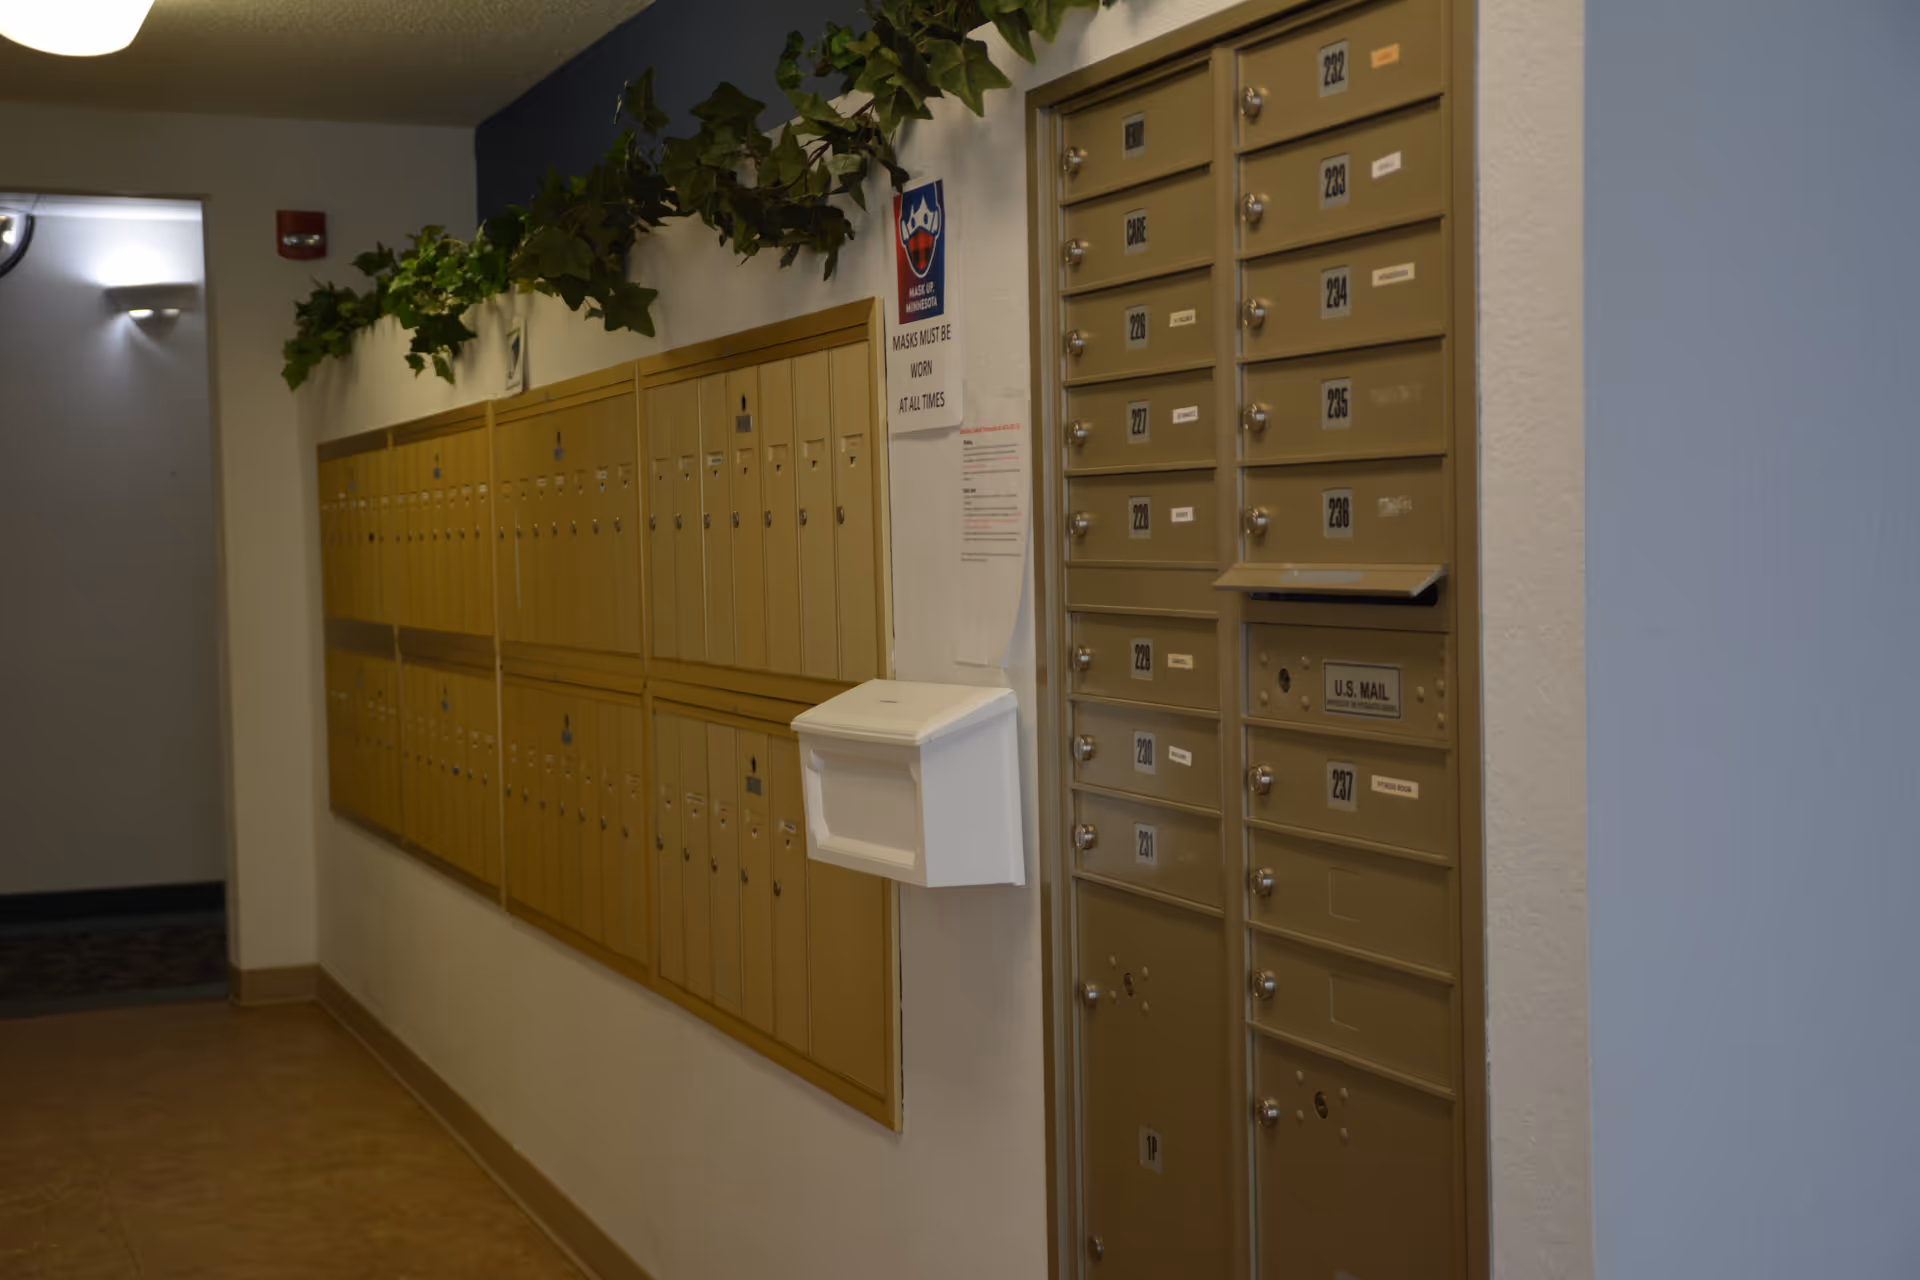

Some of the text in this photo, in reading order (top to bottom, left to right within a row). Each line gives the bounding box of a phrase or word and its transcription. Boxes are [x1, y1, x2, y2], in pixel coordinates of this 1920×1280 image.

[1324, 51, 1345, 86] 232
[1325, 163, 1346, 198] 233
[906, 296, 938, 313] MINNESOTA
[909, 284, 925, 298] MASK
[1326, 275, 1348, 309] 234
[893, 324, 952, 352] MASKS MUST BE
[910, 360, 933, 378] WORN
[899, 391, 945, 413] AT ALL TIMES
[1327, 387, 1349, 419] 235
[1132, 408, 1147, 434] 227
[1334, 679, 1390, 701] U.S. MAIL
[1137, 738, 1153, 766] 230
[1332, 769, 1353, 802] 237
[1138, 830, 1153, 859] 231
